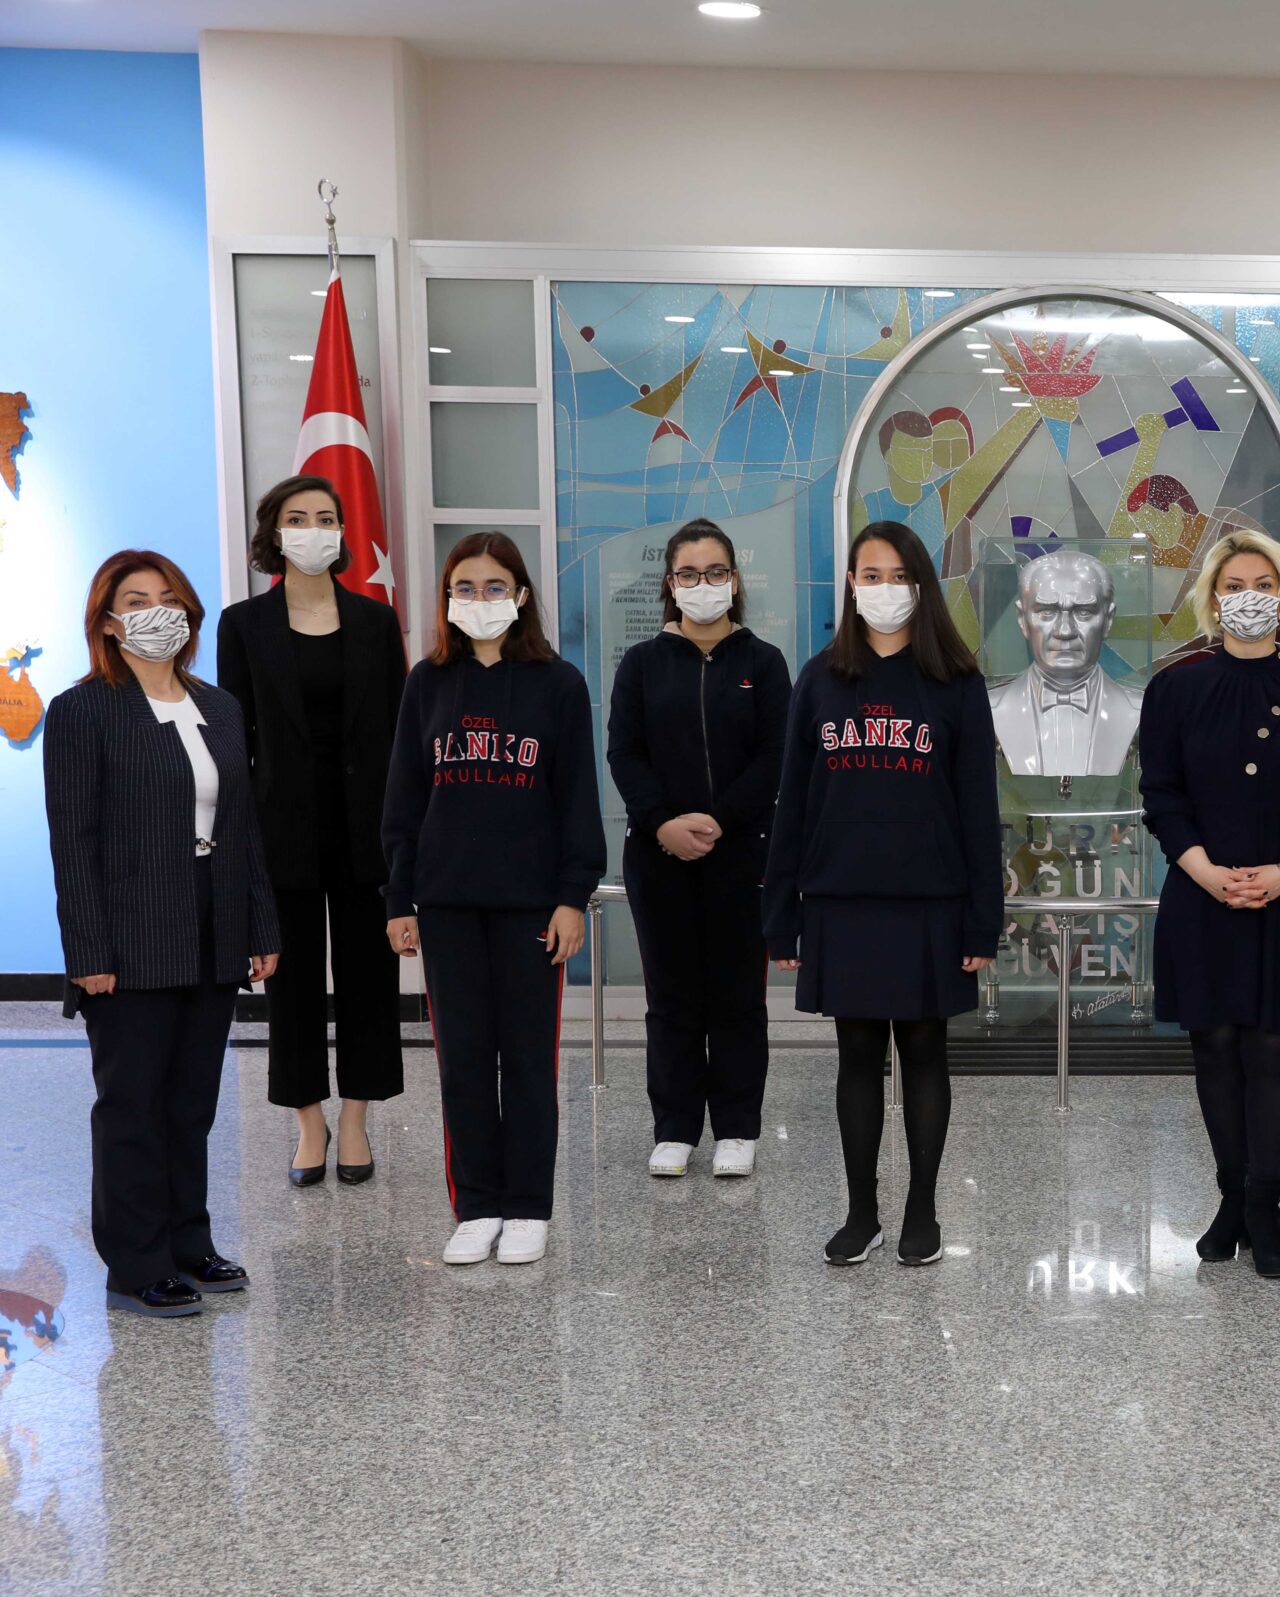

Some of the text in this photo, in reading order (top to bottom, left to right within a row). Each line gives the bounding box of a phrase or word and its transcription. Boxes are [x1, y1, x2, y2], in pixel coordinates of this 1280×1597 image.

[461, 715, 499, 729] ÖZEL
[821, 718, 933, 754] SANKO
[434, 731, 539, 767] SANKO
[827, 754, 931, 776] OKULLARI
[434, 768, 535, 790] OKULLARI
